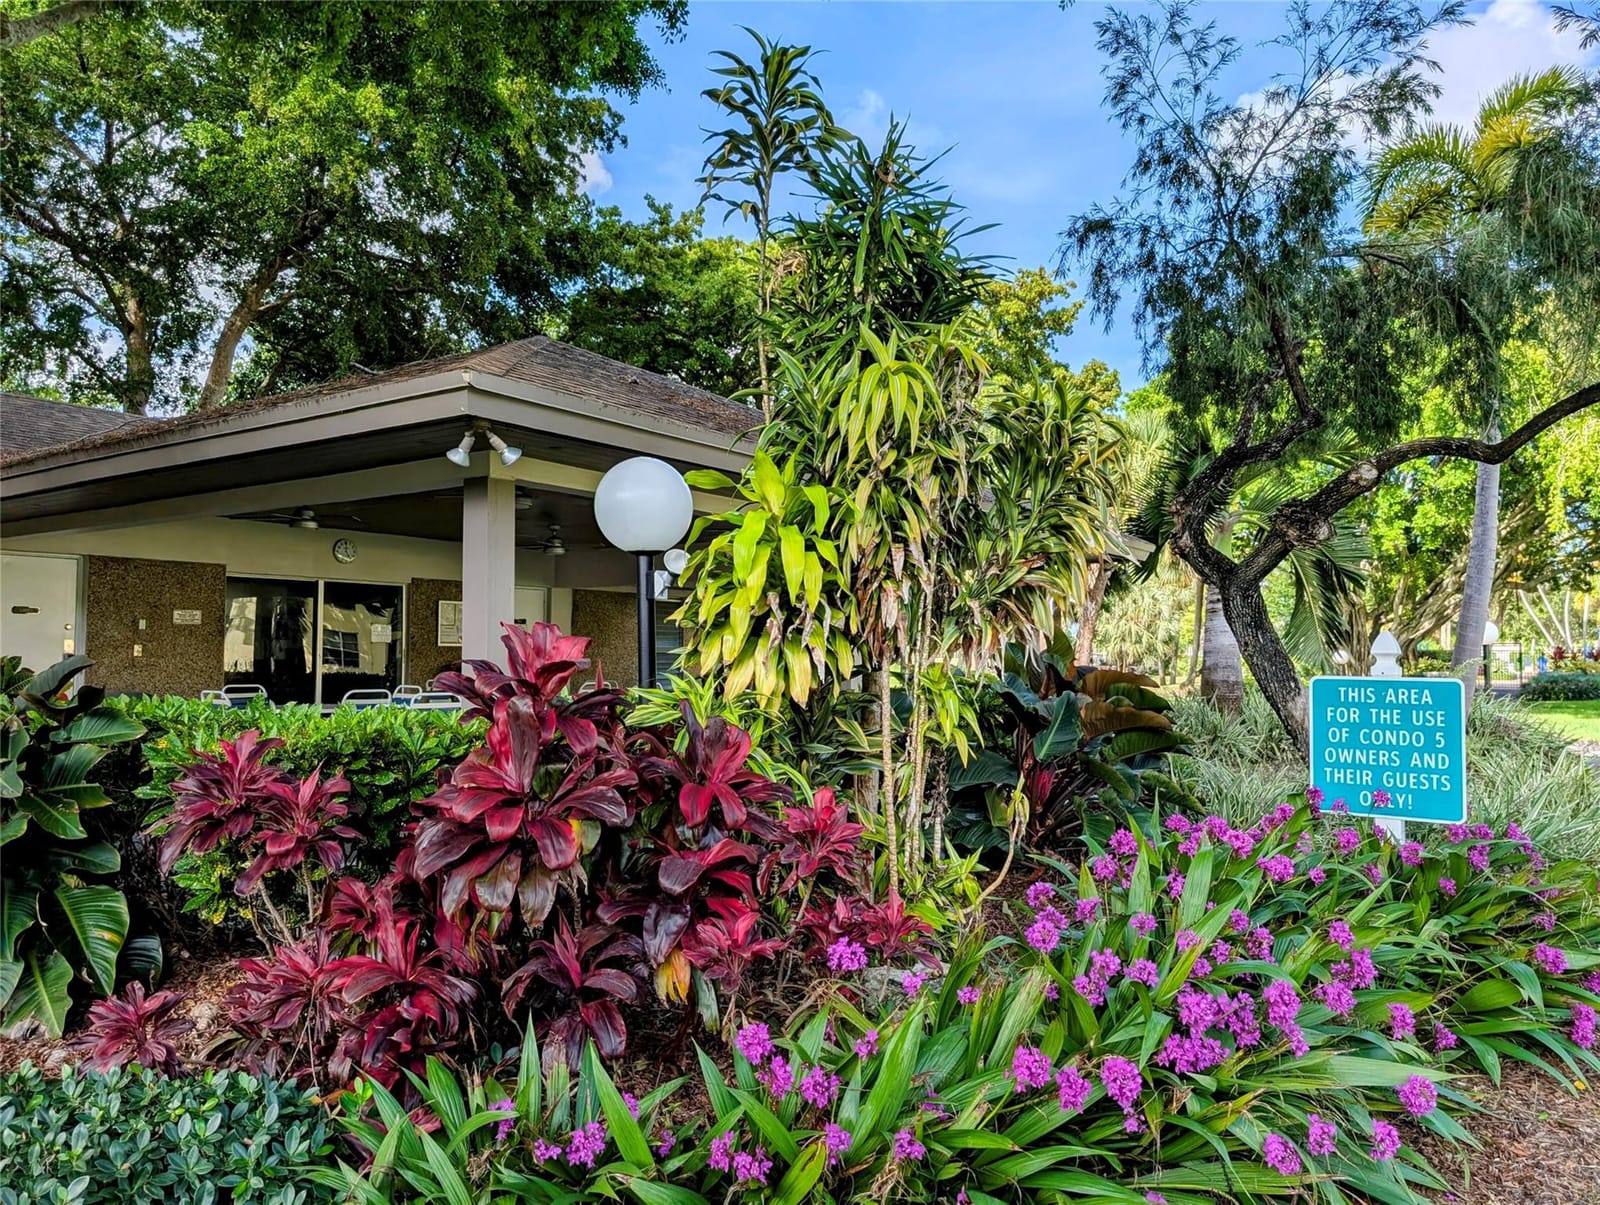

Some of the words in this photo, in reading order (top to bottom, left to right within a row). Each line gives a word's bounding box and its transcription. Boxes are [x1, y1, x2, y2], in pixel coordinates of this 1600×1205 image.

[1338, 687, 1375, 703] THIS
[1385, 689, 1432, 705] AREA
[1327, 707, 1360, 723] FOR
[1370, 709, 1401, 725] THE
[1412, 710, 1445, 726] USE
[1328, 728, 1349, 743] OF
[1360, 729, 1424, 747] CONDO
[1436, 732, 1445, 748] 5
[1326, 748, 1400, 766] OWNERS
[1410, 752, 1449, 769] AND
[1324, 768, 1372, 785] THEIR
[1383, 772, 1451, 791] GUESTS
[1360, 791, 1412, 809] OLY!
